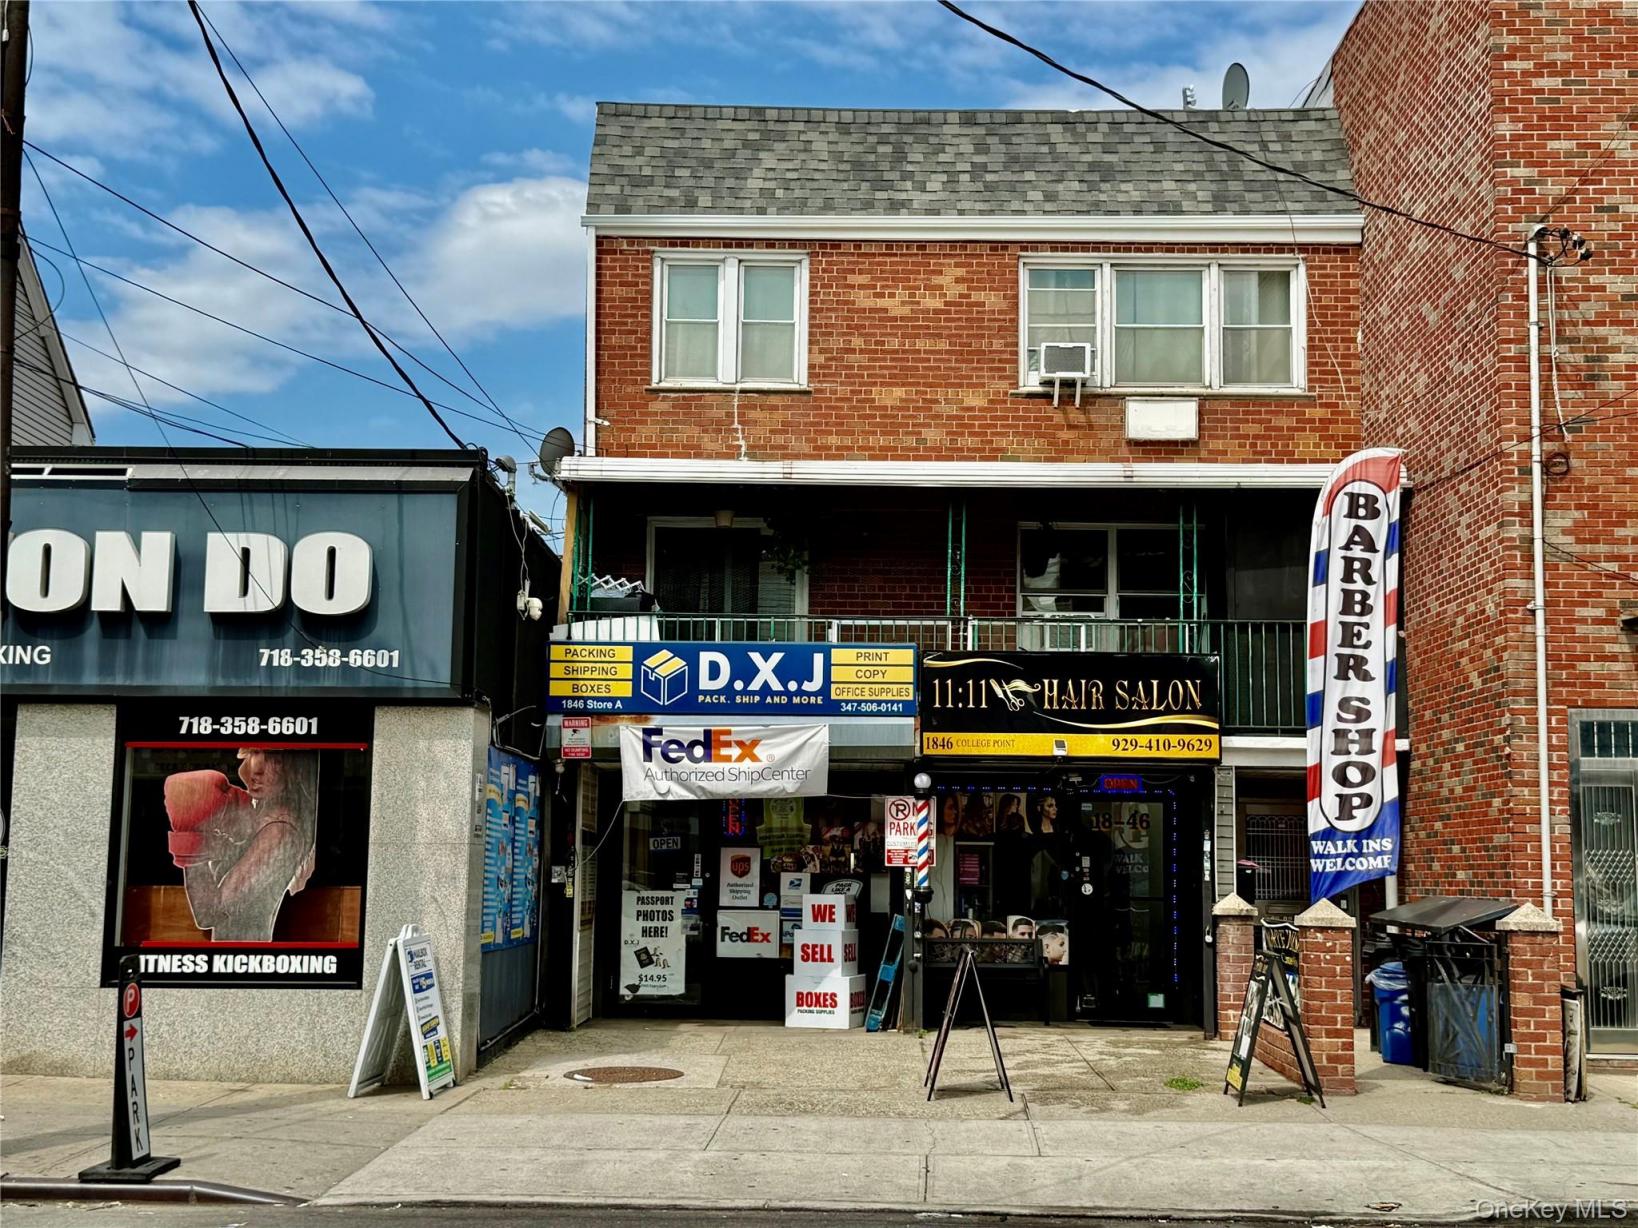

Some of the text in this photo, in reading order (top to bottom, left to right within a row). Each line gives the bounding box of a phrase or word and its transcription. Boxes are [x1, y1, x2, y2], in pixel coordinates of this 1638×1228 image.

[204, 531, 373, 615] DO
[1332, 491, 1382, 682] BARBER
[259, 648, 400, 668] 718-358-6601
[564, 648, 616, 658] PACKING
[856, 652, 890, 662] PRINT
[563, 665, 618, 676] SHIPPING
[698, 651, 824, 692] D.X.J
[855, 669, 888, 679] COPY
[572, 683, 612, 694] BOXES
[834, 687, 910, 697] OFFICE SUPPLIES
[932, 678, 1203, 711] 11:11 HAIR SALON
[561, 700, 623, 709] 1846 Store A
[735, 695, 760, 704] SHIP
[765, 696, 788, 704] AND
[792, 696, 823, 704] MORE
[840, 702, 903, 712] 347-506-0141
[178, 716, 319, 736] 718-358-6601
[641, 727, 763, 764] FedEx
[925, 736, 1016, 750] 1846 COLLEGE POINT
[1111, 737, 1213, 752] 929-410-9629
[1330, 695, 1378, 822] SHOP
[643, 766, 812, 784] Authorized ShipCenter
[1091, 810, 1150, 831] 18-46
[652, 838, 679, 849] OPEN
[1310, 837, 1393, 855] WALK INS
[636, 896, 675, 905] PASSPORT
[636, 909, 674, 922] PHOTOS
[811, 904, 836, 923] WE
[641, 926, 668, 938] HERE!
[720, 926, 772, 943] FedEx
[800, 943, 835, 963] SELL
[843, 943, 857, 963] SELL
[211, 953, 337, 975] KICKBOXING
[638, 974, 667, 983] $14.95
[796, 991, 838, 1008] BOXES
[128, 1047, 143, 1152] PARK
